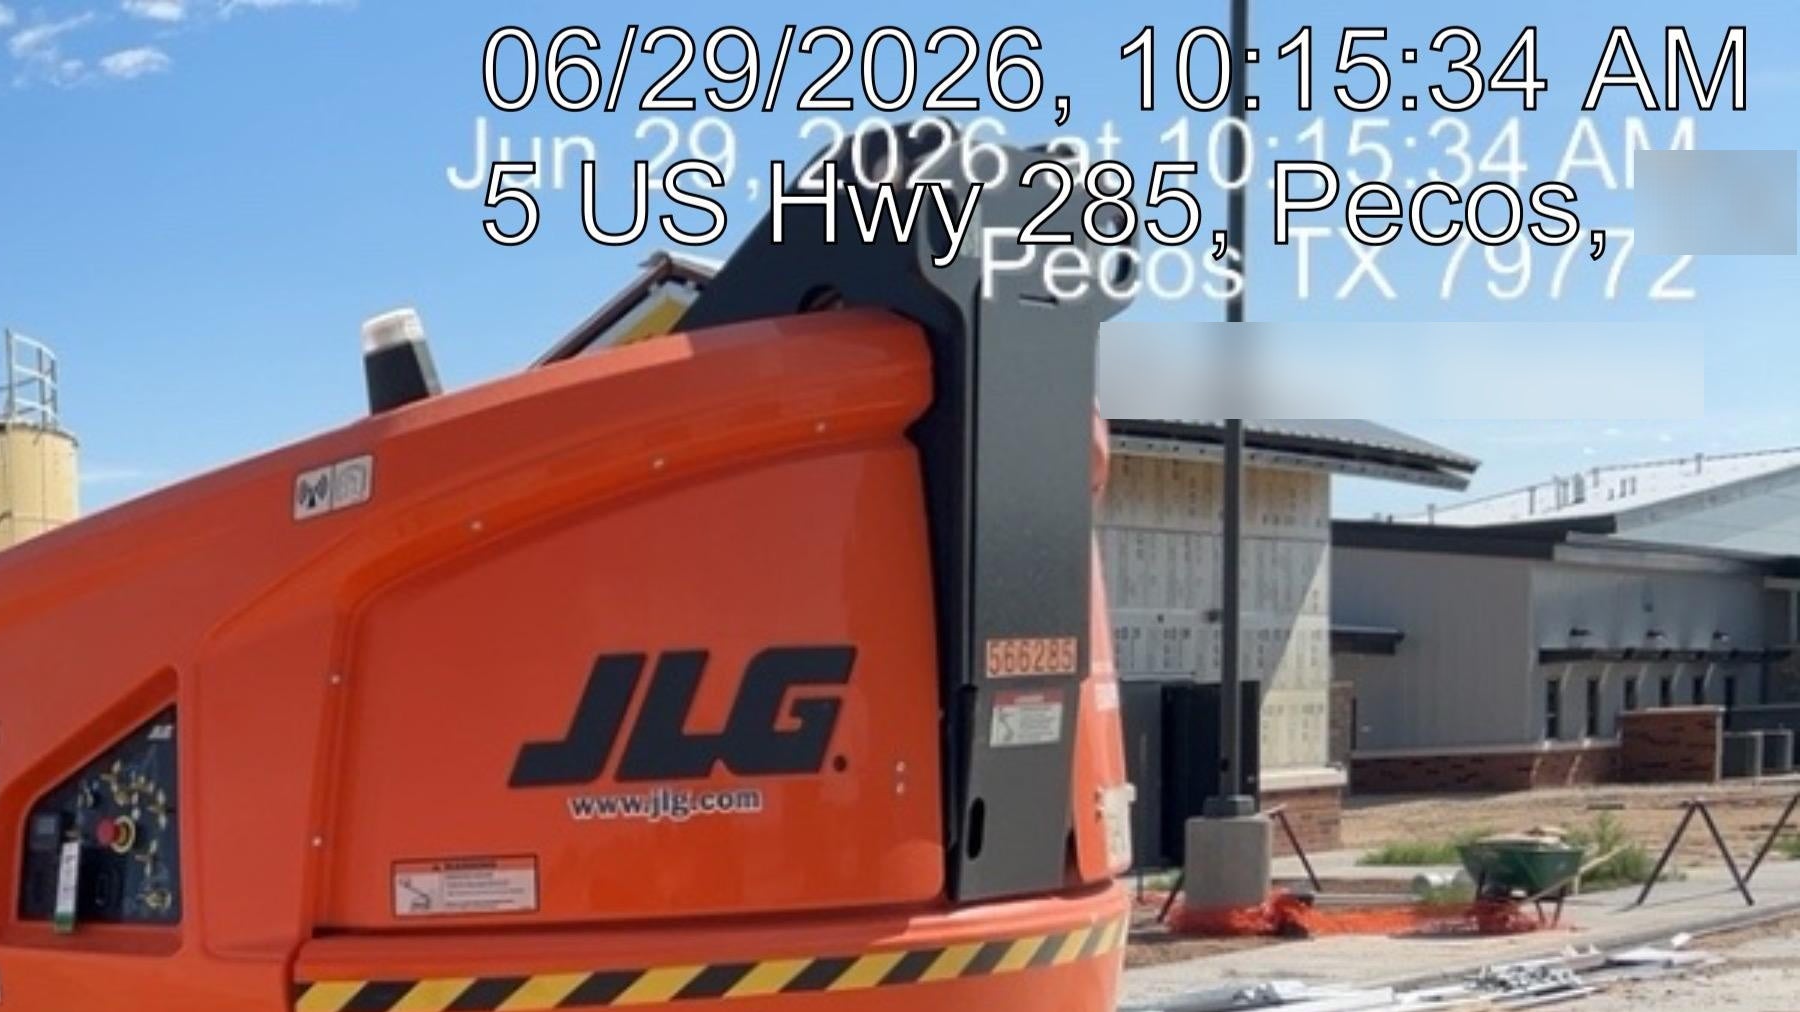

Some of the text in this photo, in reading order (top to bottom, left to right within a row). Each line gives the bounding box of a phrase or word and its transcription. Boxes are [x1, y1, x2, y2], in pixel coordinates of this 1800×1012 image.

[989, 637, 1074, 675] 566285
[506, 643, 857, 789] JLG
[568, 787, 762, 820] www.jlg.com
